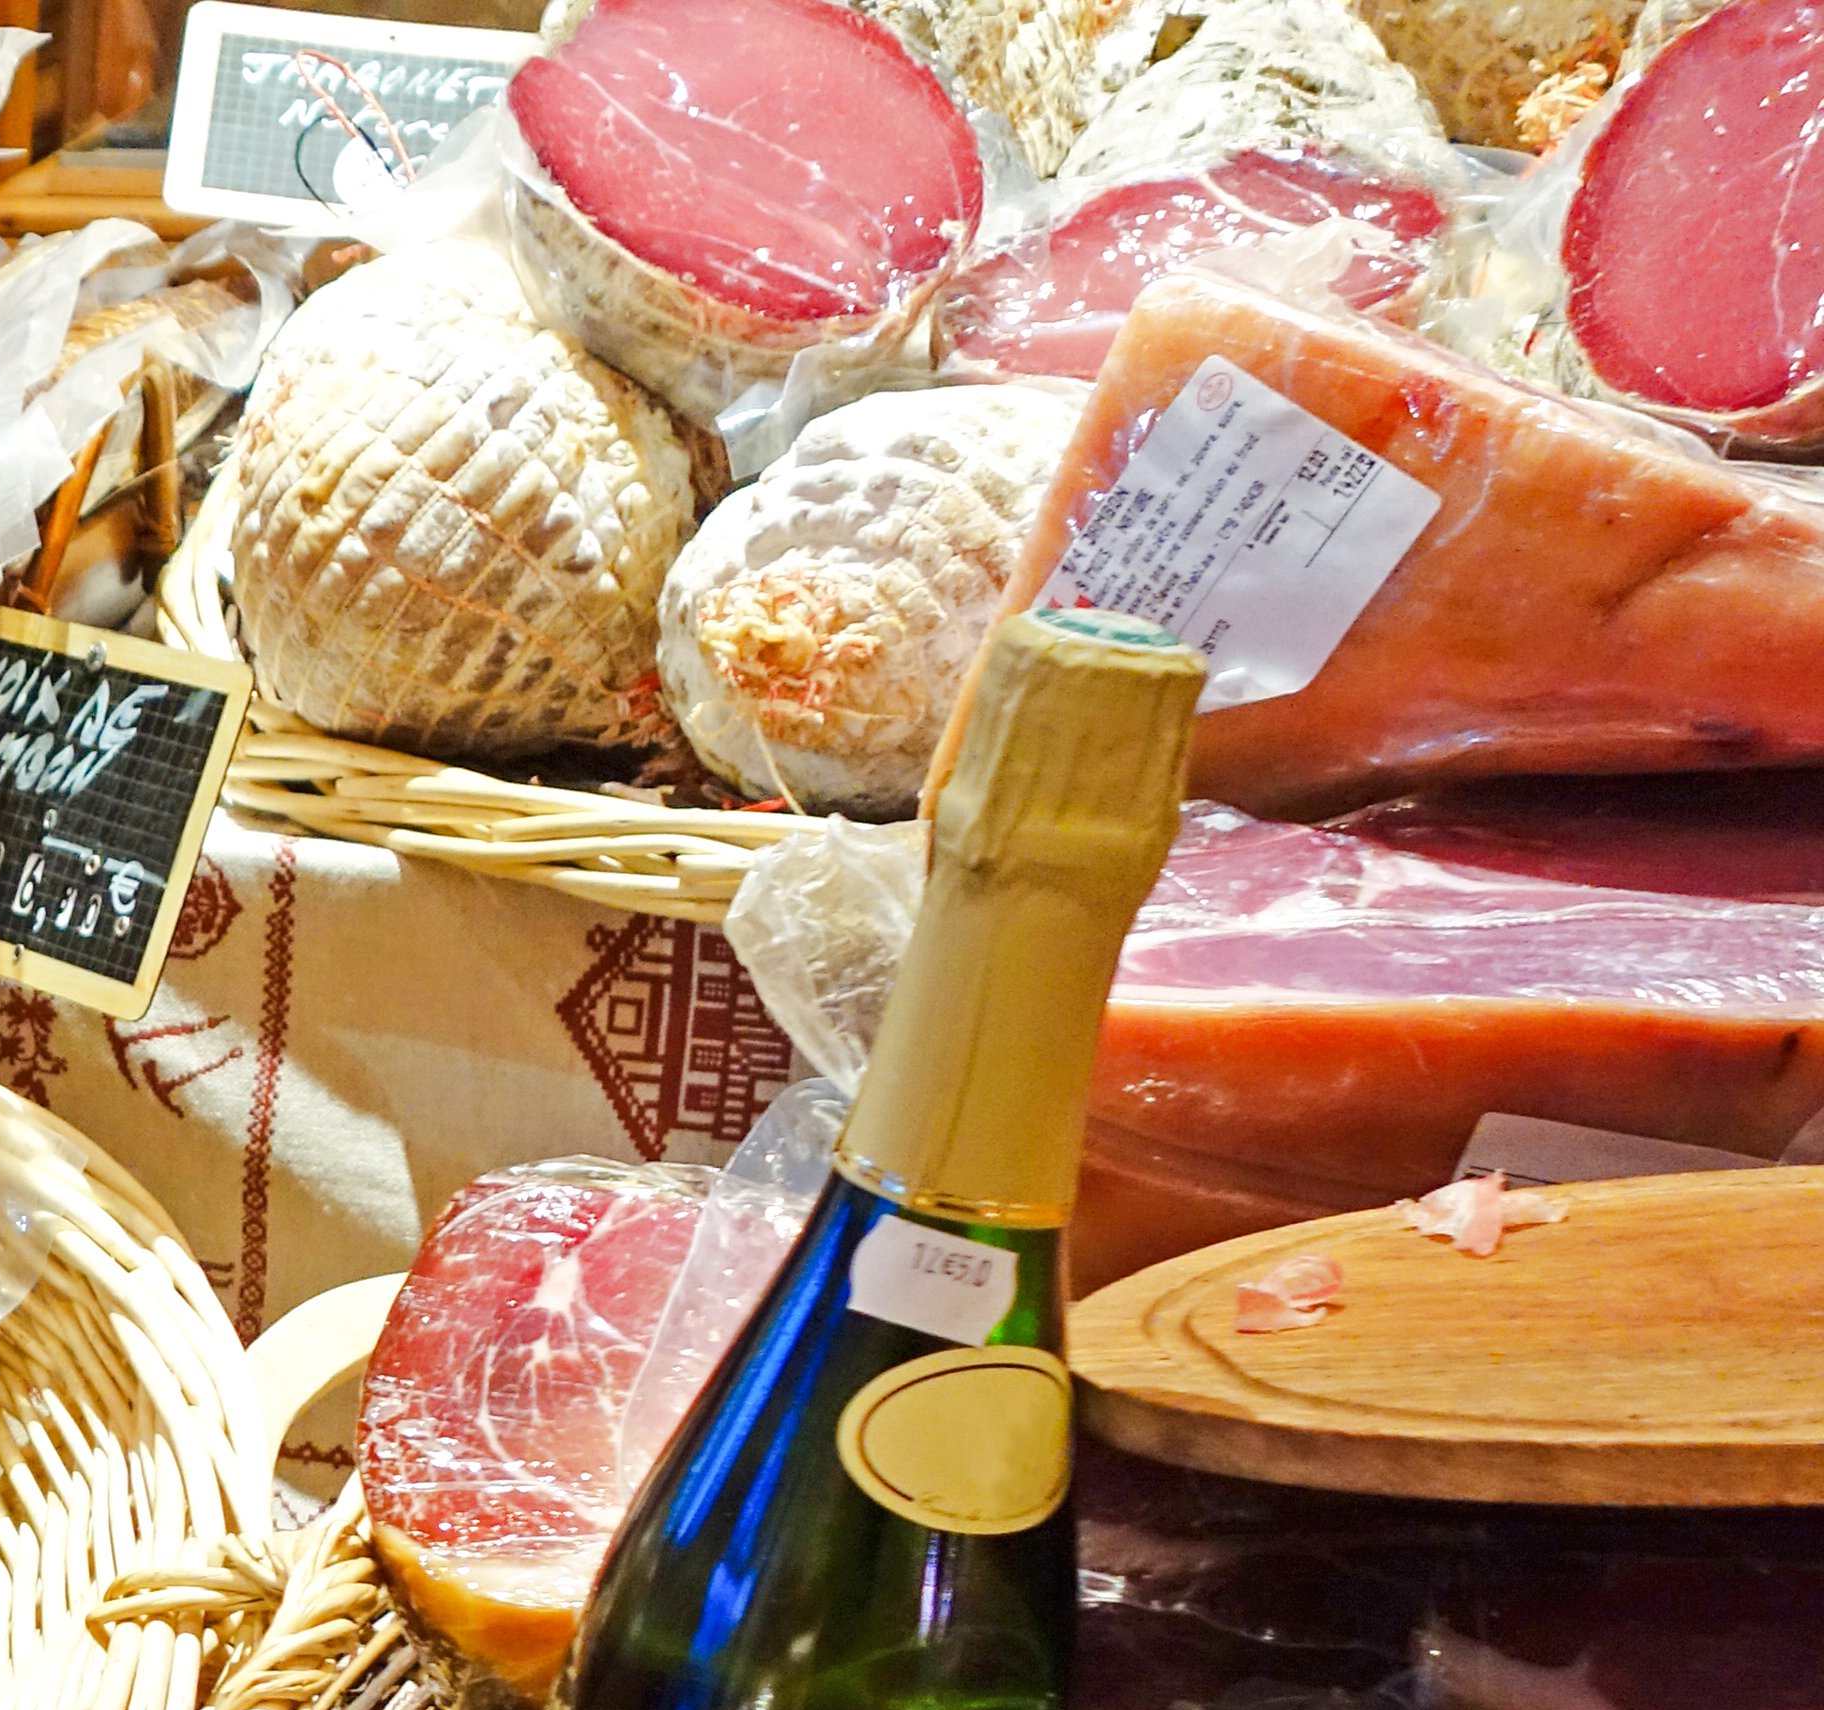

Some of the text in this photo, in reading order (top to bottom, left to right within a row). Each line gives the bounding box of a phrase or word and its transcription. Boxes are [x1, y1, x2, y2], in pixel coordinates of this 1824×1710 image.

[1082, 486, 1128, 544] JAMBON
[1115, 488, 1153, 533] NATURE
[67, 679, 169, 750] DE
